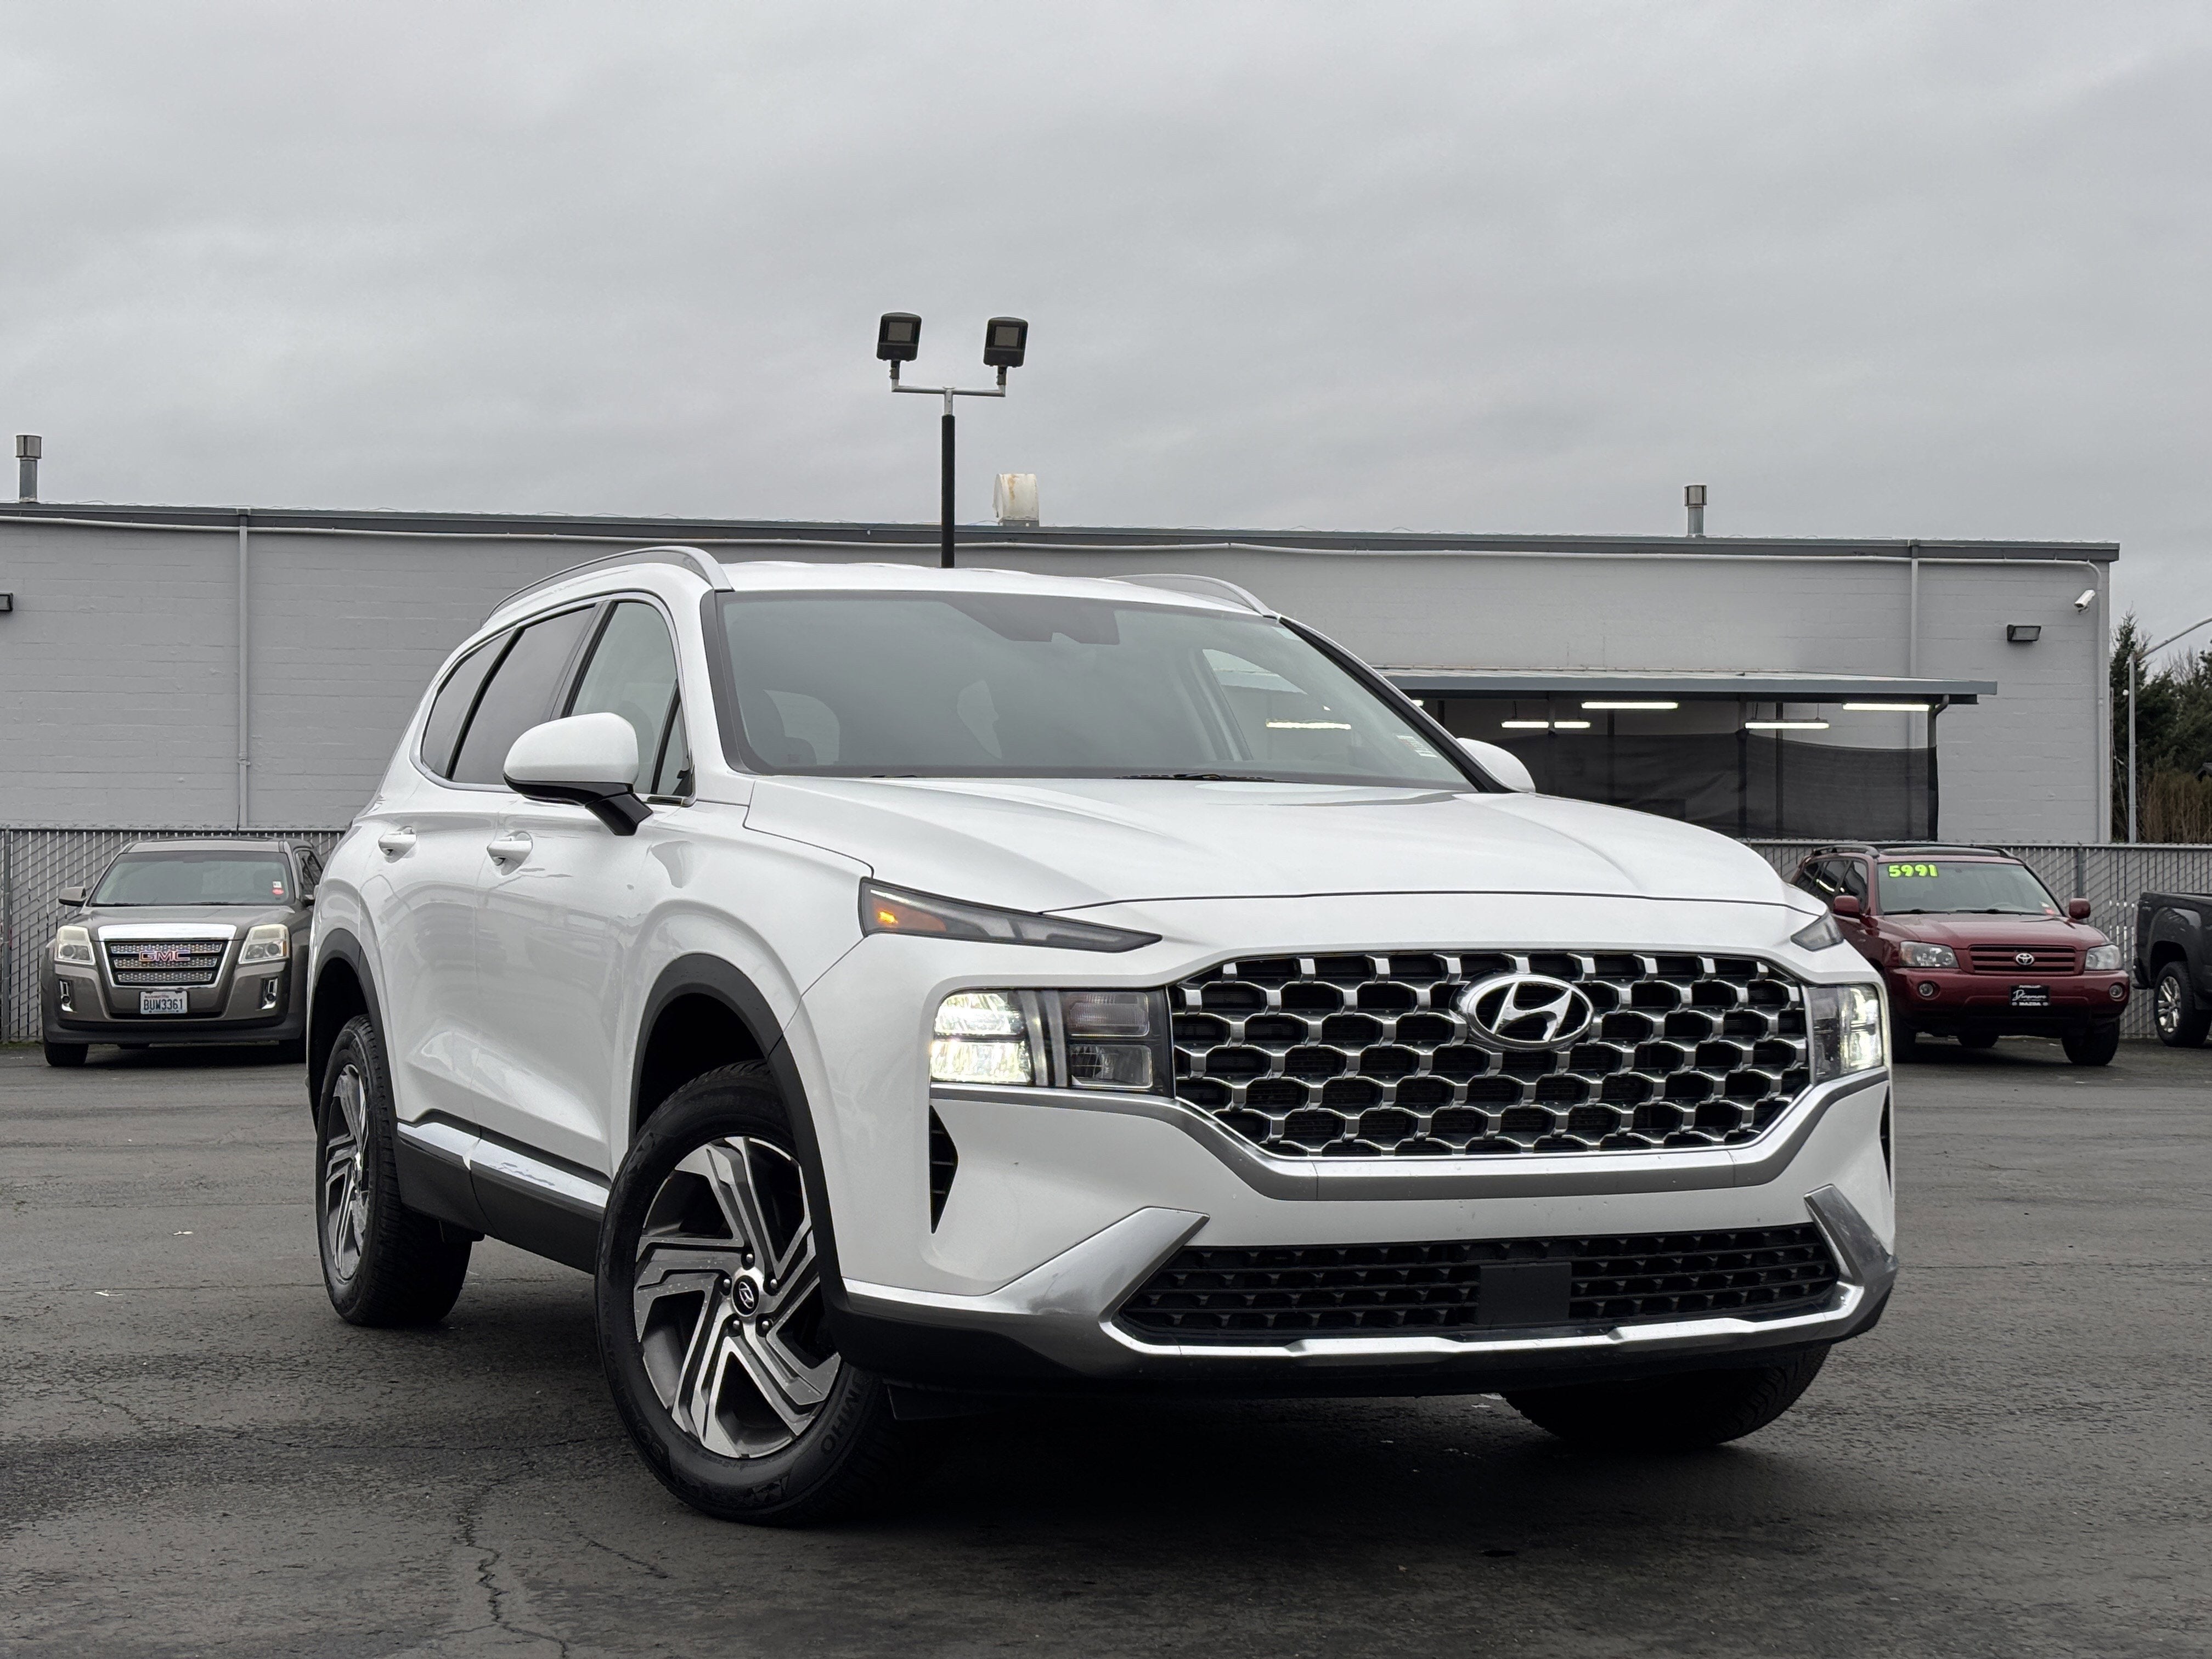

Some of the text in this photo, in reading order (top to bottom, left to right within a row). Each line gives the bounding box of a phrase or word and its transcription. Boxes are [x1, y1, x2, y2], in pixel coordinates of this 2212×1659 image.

[1888, 864, 1939, 878] 5991
[139, 950, 191, 962] GMC
[144, 999, 183, 1010] BUW3361
